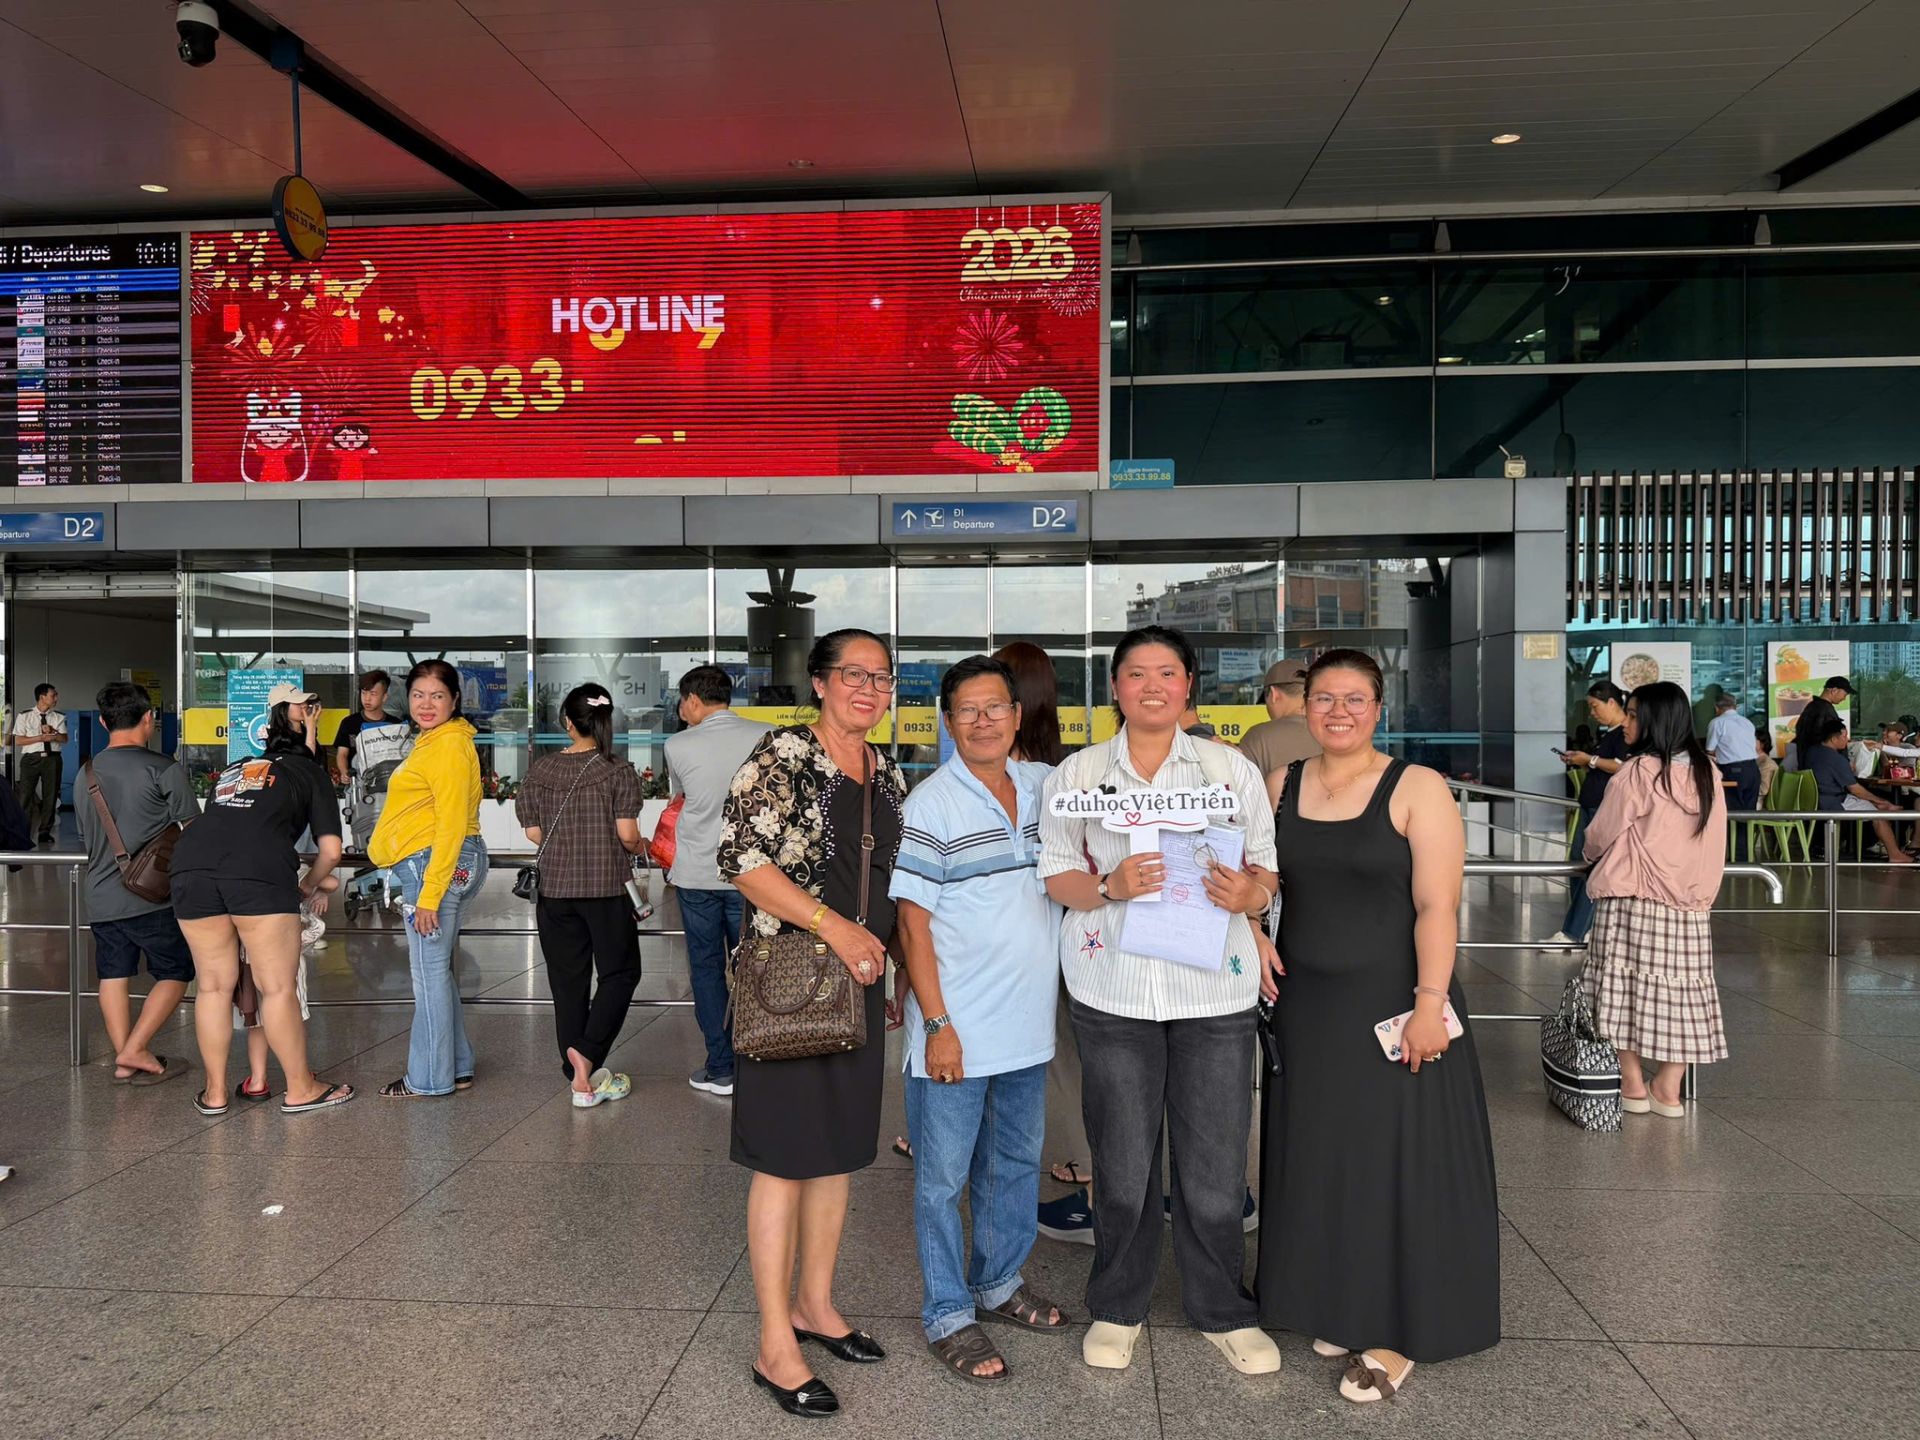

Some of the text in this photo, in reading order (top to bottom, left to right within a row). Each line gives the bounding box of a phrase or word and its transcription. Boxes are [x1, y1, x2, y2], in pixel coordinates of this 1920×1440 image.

[21, 243, 111, 269] Departures
[136, 242, 177, 264] 10:11
[960, 226, 1075, 282] 2026
[551, 295, 725, 334] HOTLINE
[953, 508, 965, 517] ĐI
[1032, 507, 1066, 528] D2
[64, 517, 95, 537] D2
[953, 520, 995, 530] Departure
[1054, 788, 1236, 815] #duhọcViệtTriển
